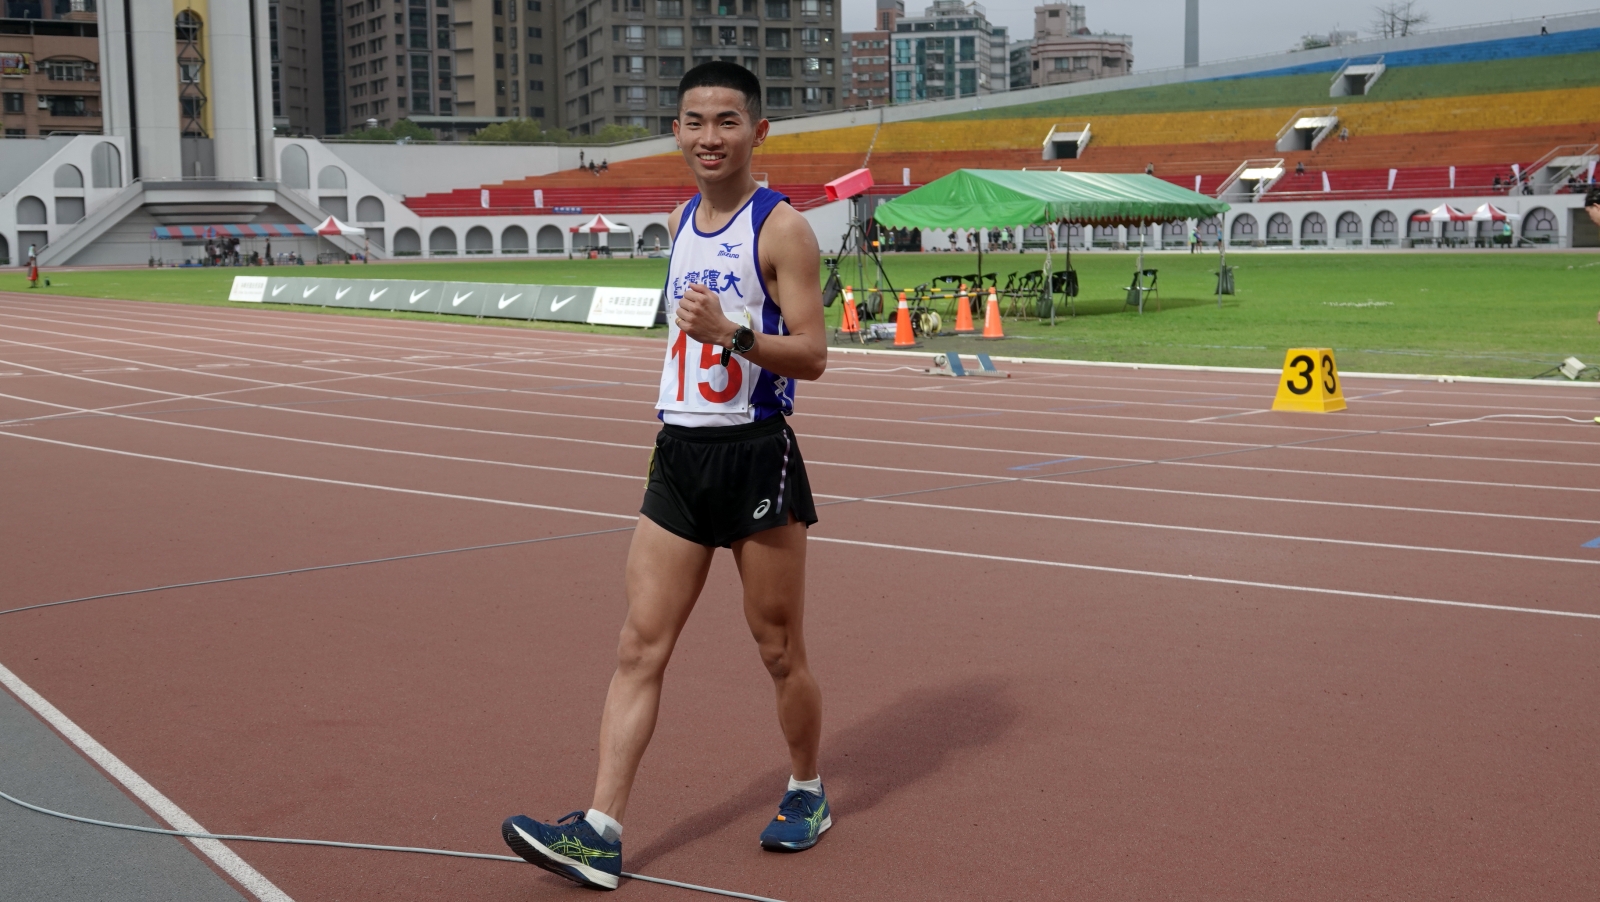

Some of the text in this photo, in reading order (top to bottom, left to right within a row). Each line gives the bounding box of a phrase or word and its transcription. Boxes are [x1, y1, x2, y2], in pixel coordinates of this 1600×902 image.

[671, 329, 743, 404] 15
[1286, 354, 1315, 396] 3
[1322, 354, 1337, 395] 3
